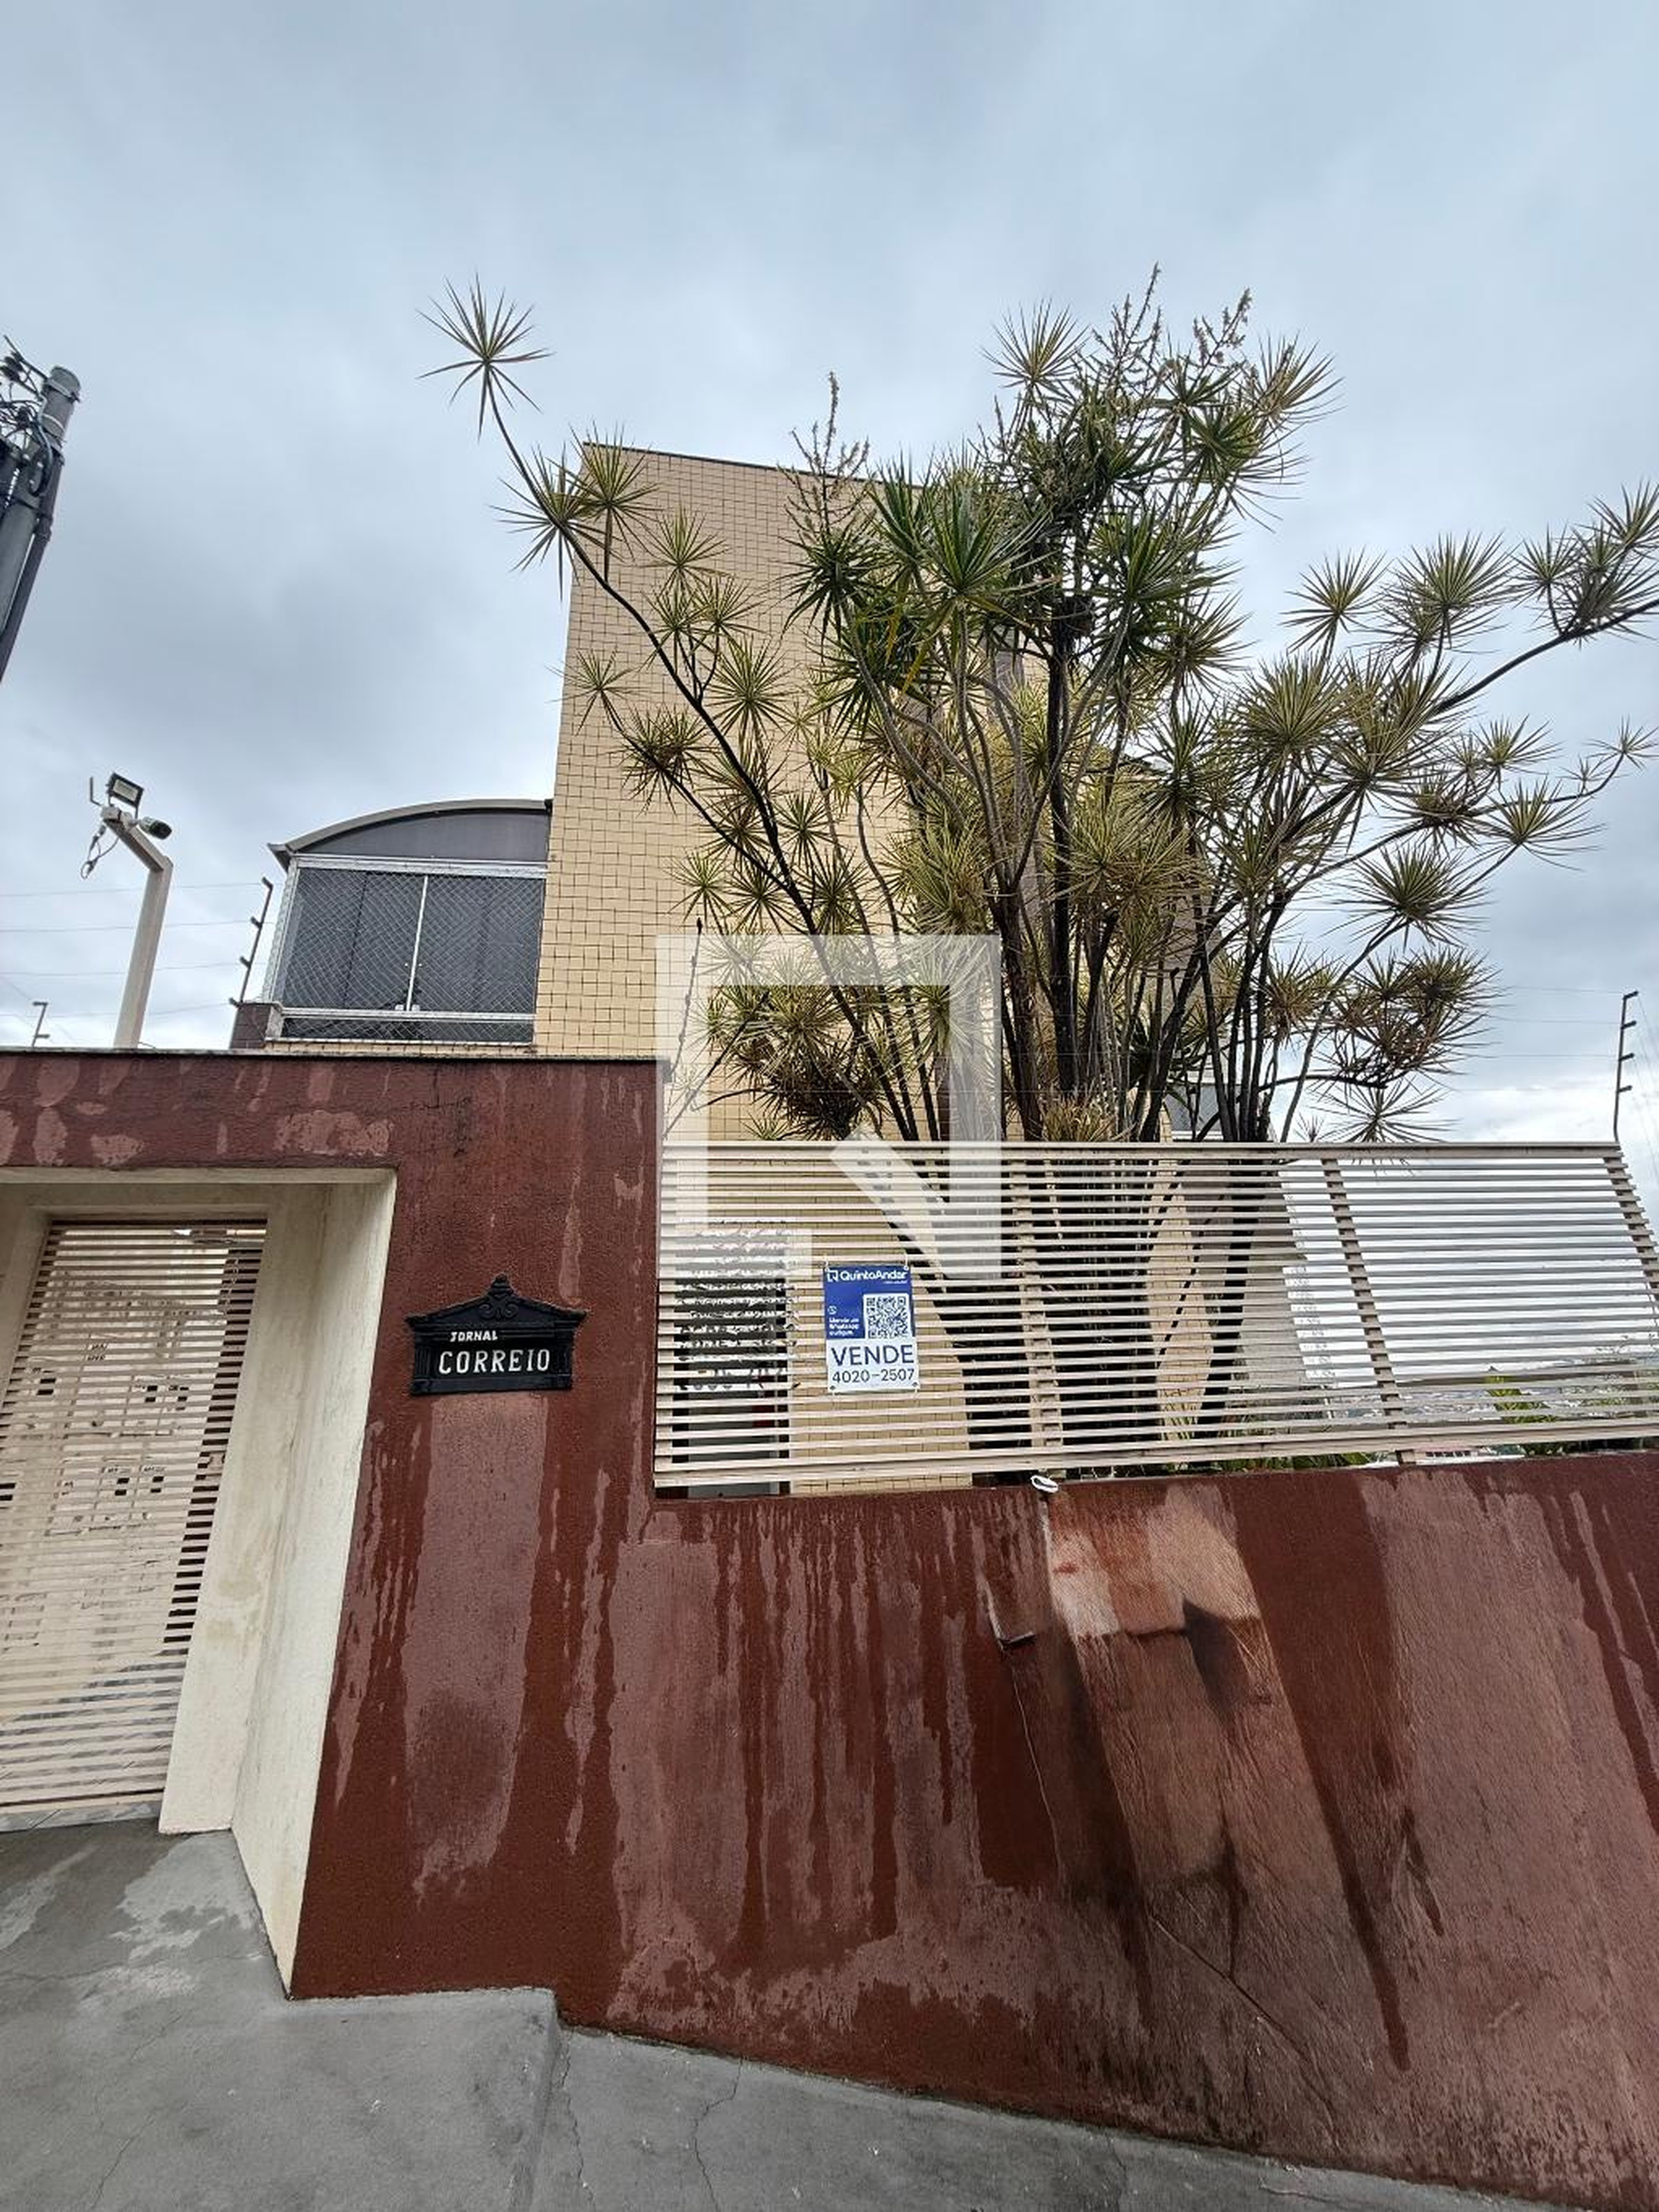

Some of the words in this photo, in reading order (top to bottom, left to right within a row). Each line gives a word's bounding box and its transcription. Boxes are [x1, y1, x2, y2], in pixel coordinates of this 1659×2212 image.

[840, 1270, 907, 1280] QuintoAndar
[450, 1330, 499, 1343] JORNAL
[439, 1349, 550, 1374] CORREIO
[831, 1345, 915, 1366] VENDE
[832, 1369, 915, 1383] 4020-2507
